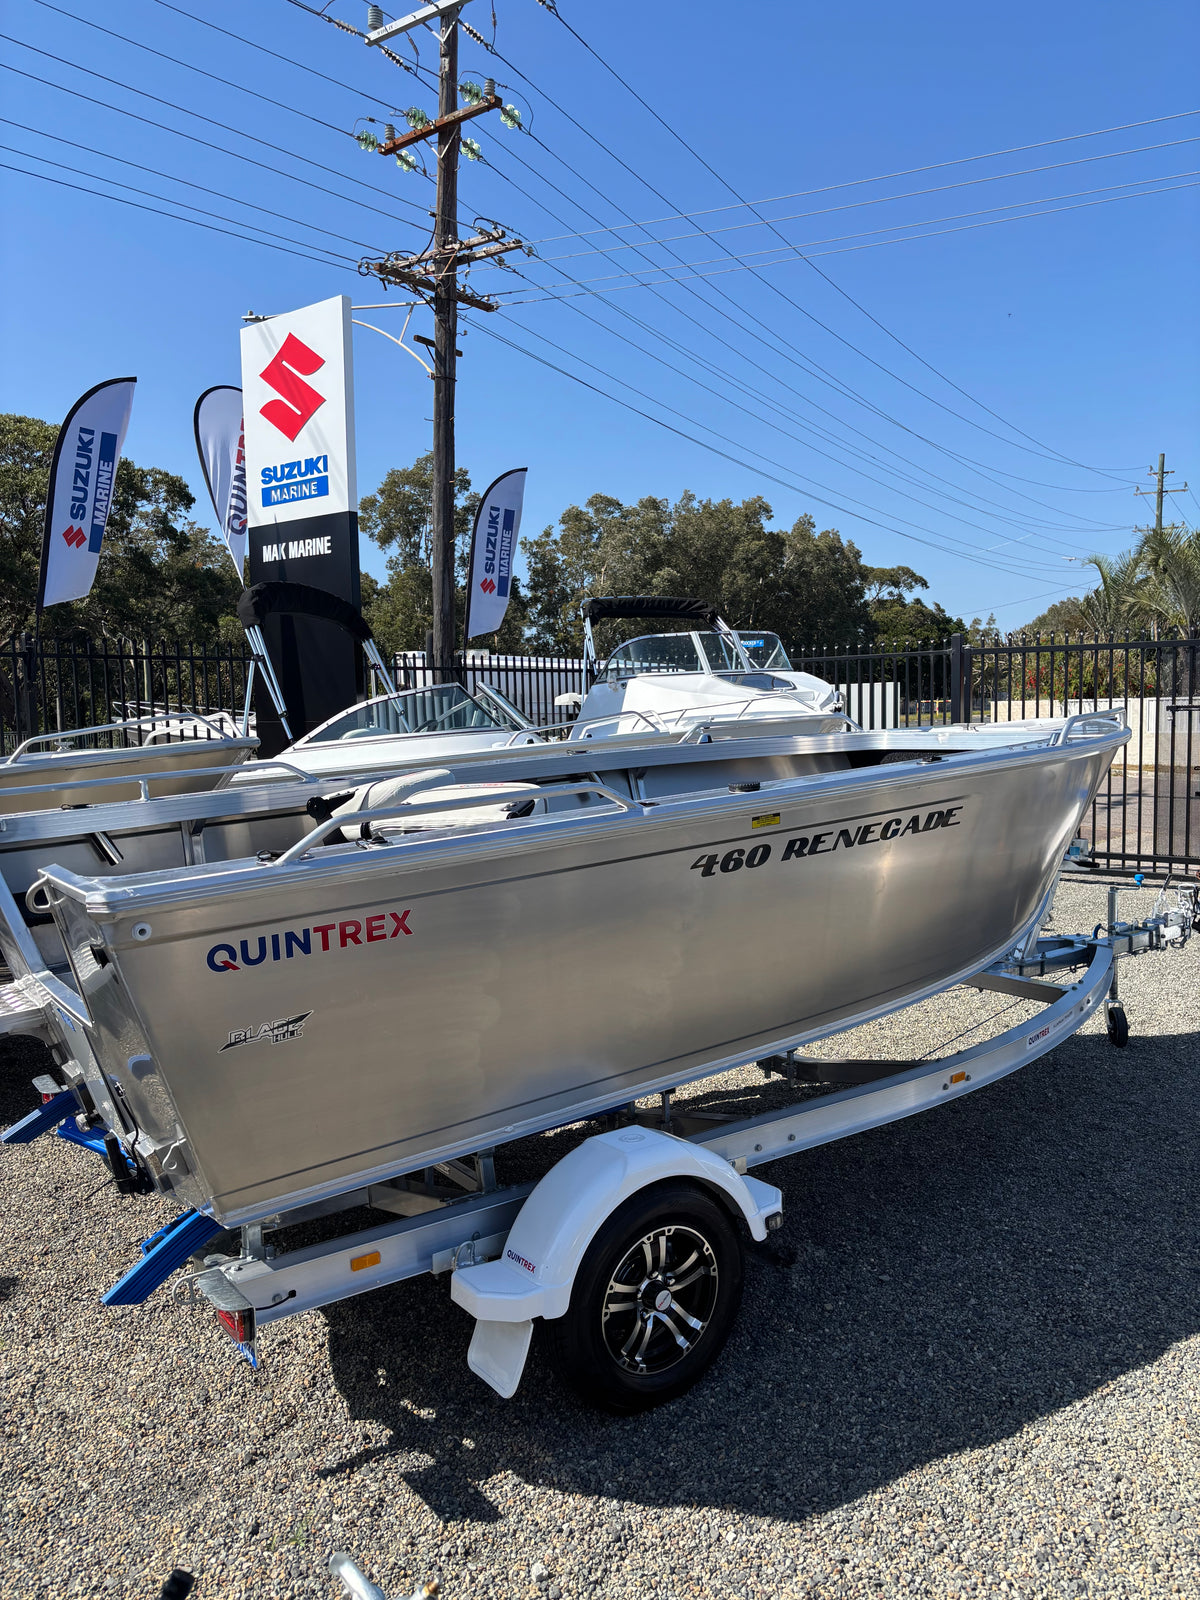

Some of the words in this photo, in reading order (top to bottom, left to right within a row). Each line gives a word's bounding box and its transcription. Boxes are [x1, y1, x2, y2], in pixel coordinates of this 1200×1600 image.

[70, 426, 95, 521] SUZUKI
[93, 459, 113, 527] MARINE
[261, 454, 329, 485] SUZUKI
[270, 480, 319, 503] MARINE
[262, 541, 287, 563] MAK
[288, 535, 332, 559] MARINE
[485, 506, 500, 574] SUZUKI
[500, 529, 511, 577] MARINE
[690, 844, 772, 878] 460
[780, 805, 964, 862] RENEGADE
[206, 909, 414, 973] QUINTREX
[1029, 1027, 1049, 1045] QUINTREX
[507, 1250, 536, 1273] QUINTREX
